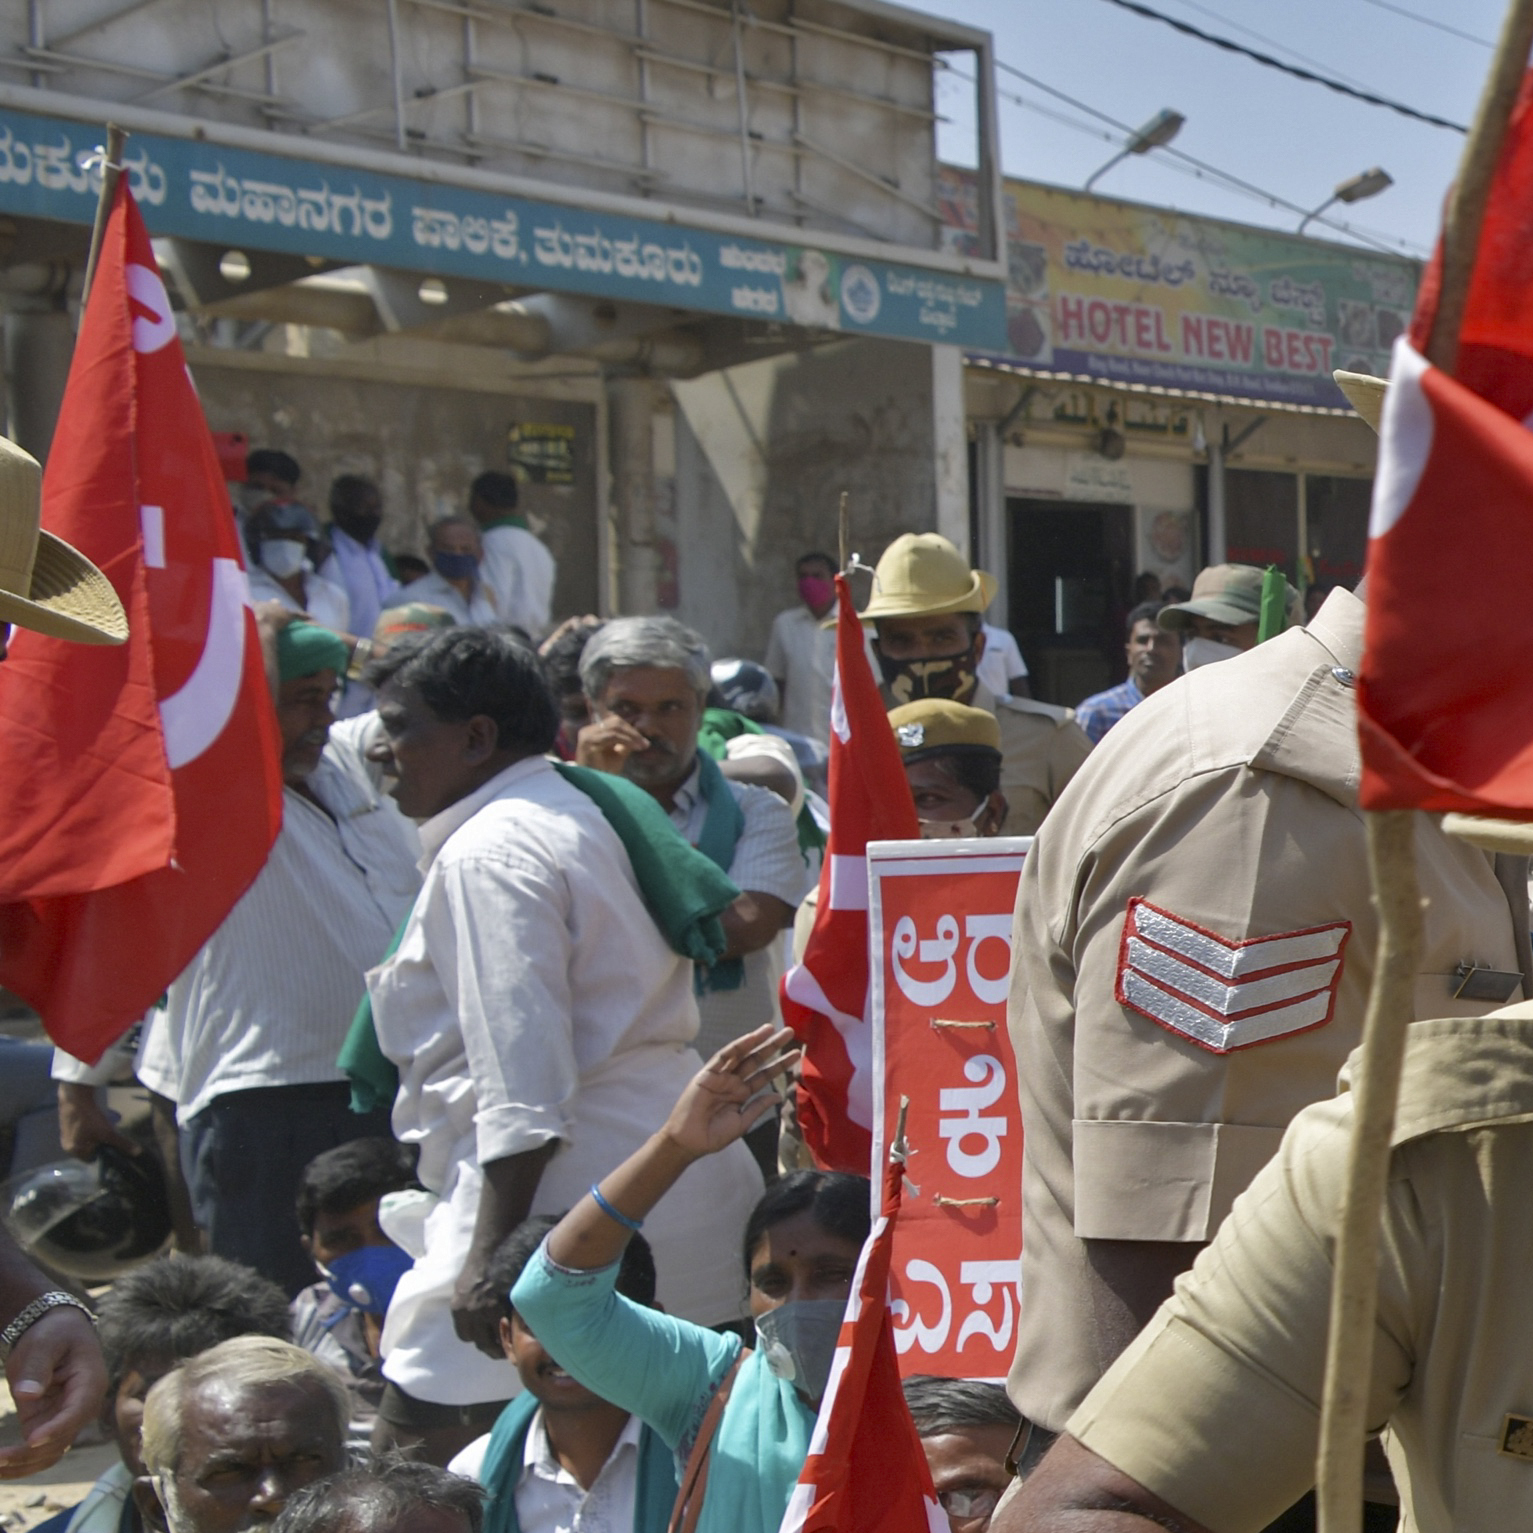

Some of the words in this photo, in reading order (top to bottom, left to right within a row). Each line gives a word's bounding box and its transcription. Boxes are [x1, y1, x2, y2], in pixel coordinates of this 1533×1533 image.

[0, 125, 167, 206] ಮಕೂರು
[189, 161, 393, 241] ಮಹಾನಗರ
[412, 206, 528, 266] ಪಾಲಿಕೆ,
[533, 219, 702, 287] ತುಮಕೂರು
[1064, 240, 1196, 287] ಹೋಟೆಲ್
[1060, 296, 1172, 353] HOTEL
[1181, 316, 1254, 364] NEW
[1263, 329, 1335, 374] BEST
[892, 914, 1014, 1007] ಆರ
